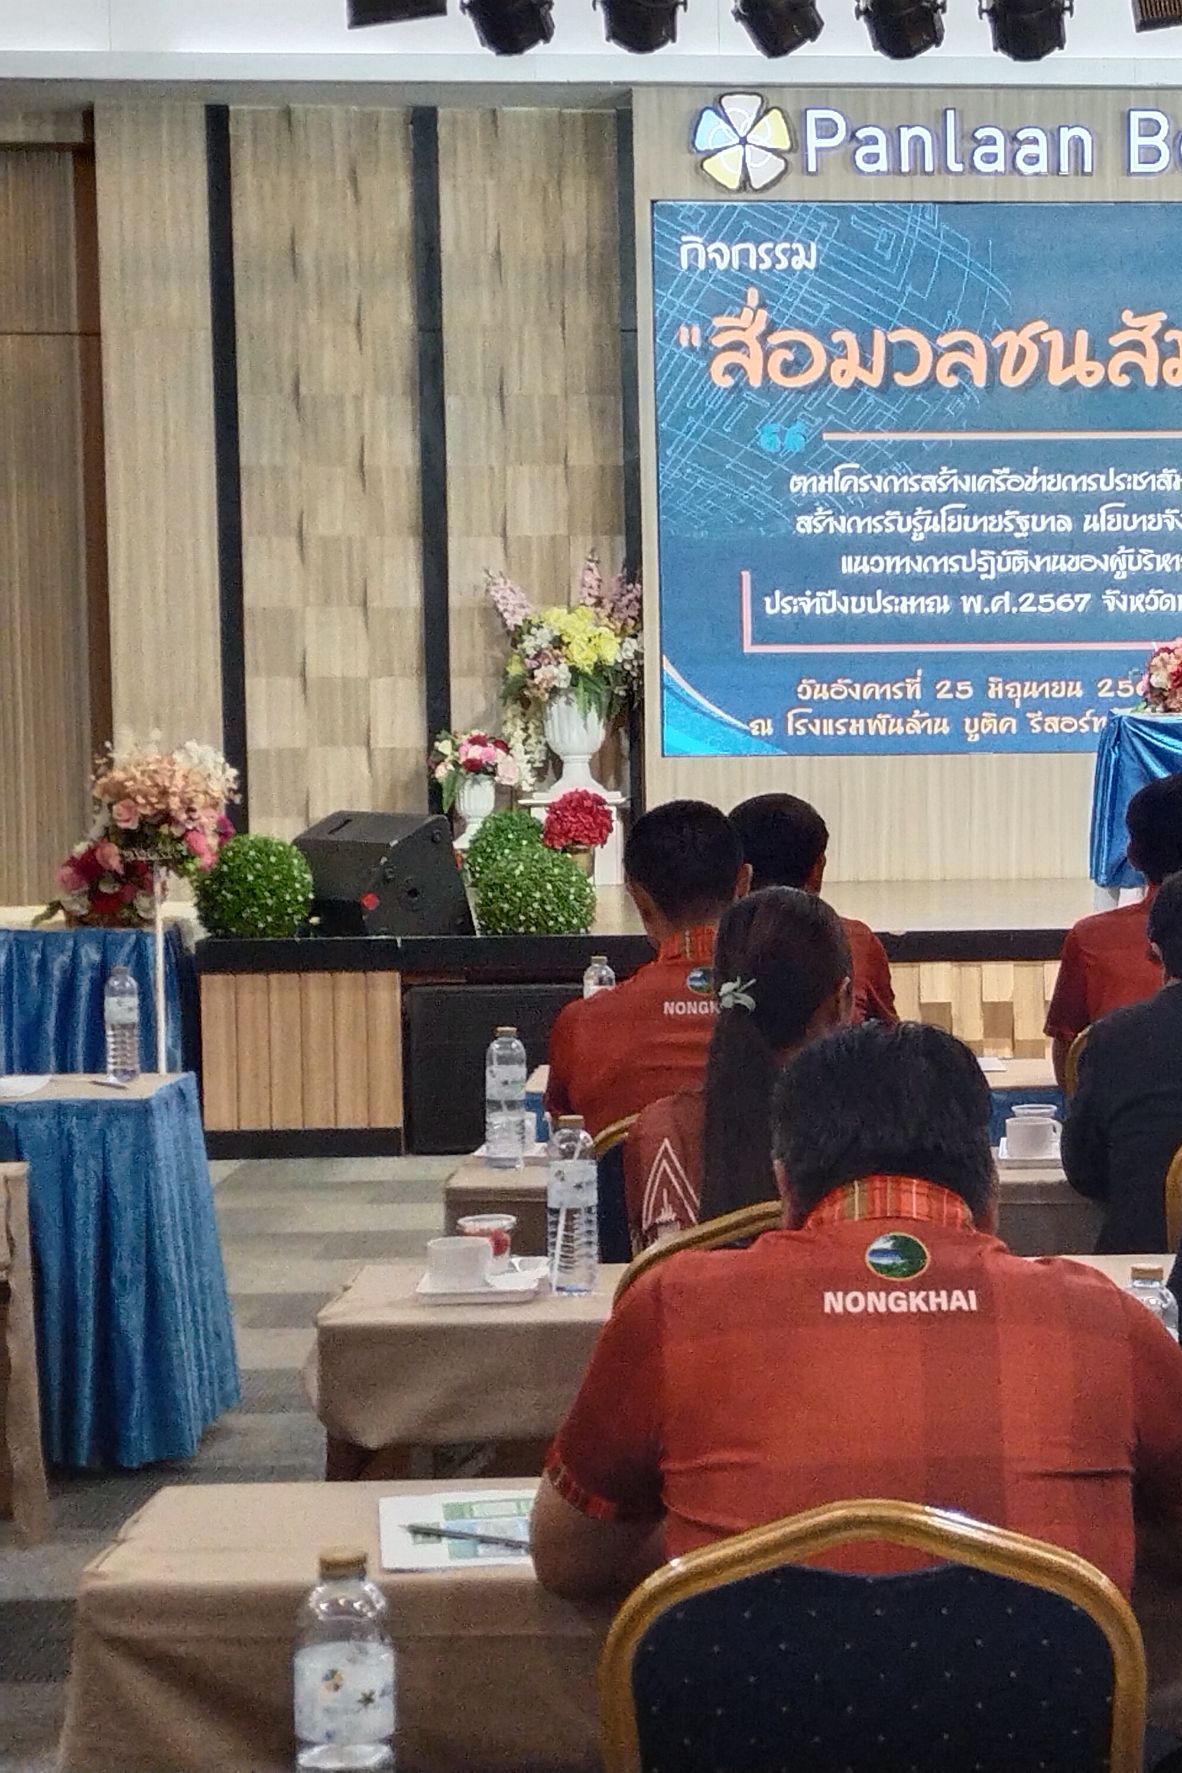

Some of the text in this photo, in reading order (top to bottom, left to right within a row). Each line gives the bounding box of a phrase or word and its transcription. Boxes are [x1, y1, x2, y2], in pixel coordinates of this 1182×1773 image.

[804, 107, 1094, 175] Panlaan
[679, 235, 817, 271] กิจกรรม
[795, 503, 1073, 541] สร้างการรับรู้นโยบายรัฐบาล
[764, 589, 950, 615] ประจำปีงบประมาณ
[961, 590, 1092, 614] พ.ศ.2567
[797, 668, 922, 700] วันอังคารที่
[935, 679, 973, 699] 25
[986, 676, 1083, 708] มิถุนายน
[750, 717, 774, 736] ณ
[787, 708, 950, 736] โรงแรมพันล้าน
[963, 712, 1017, 742] บูติค
[663, 1001, 721, 1015] NONGK
[823, 1289, 978, 1313] NONGKHAI
